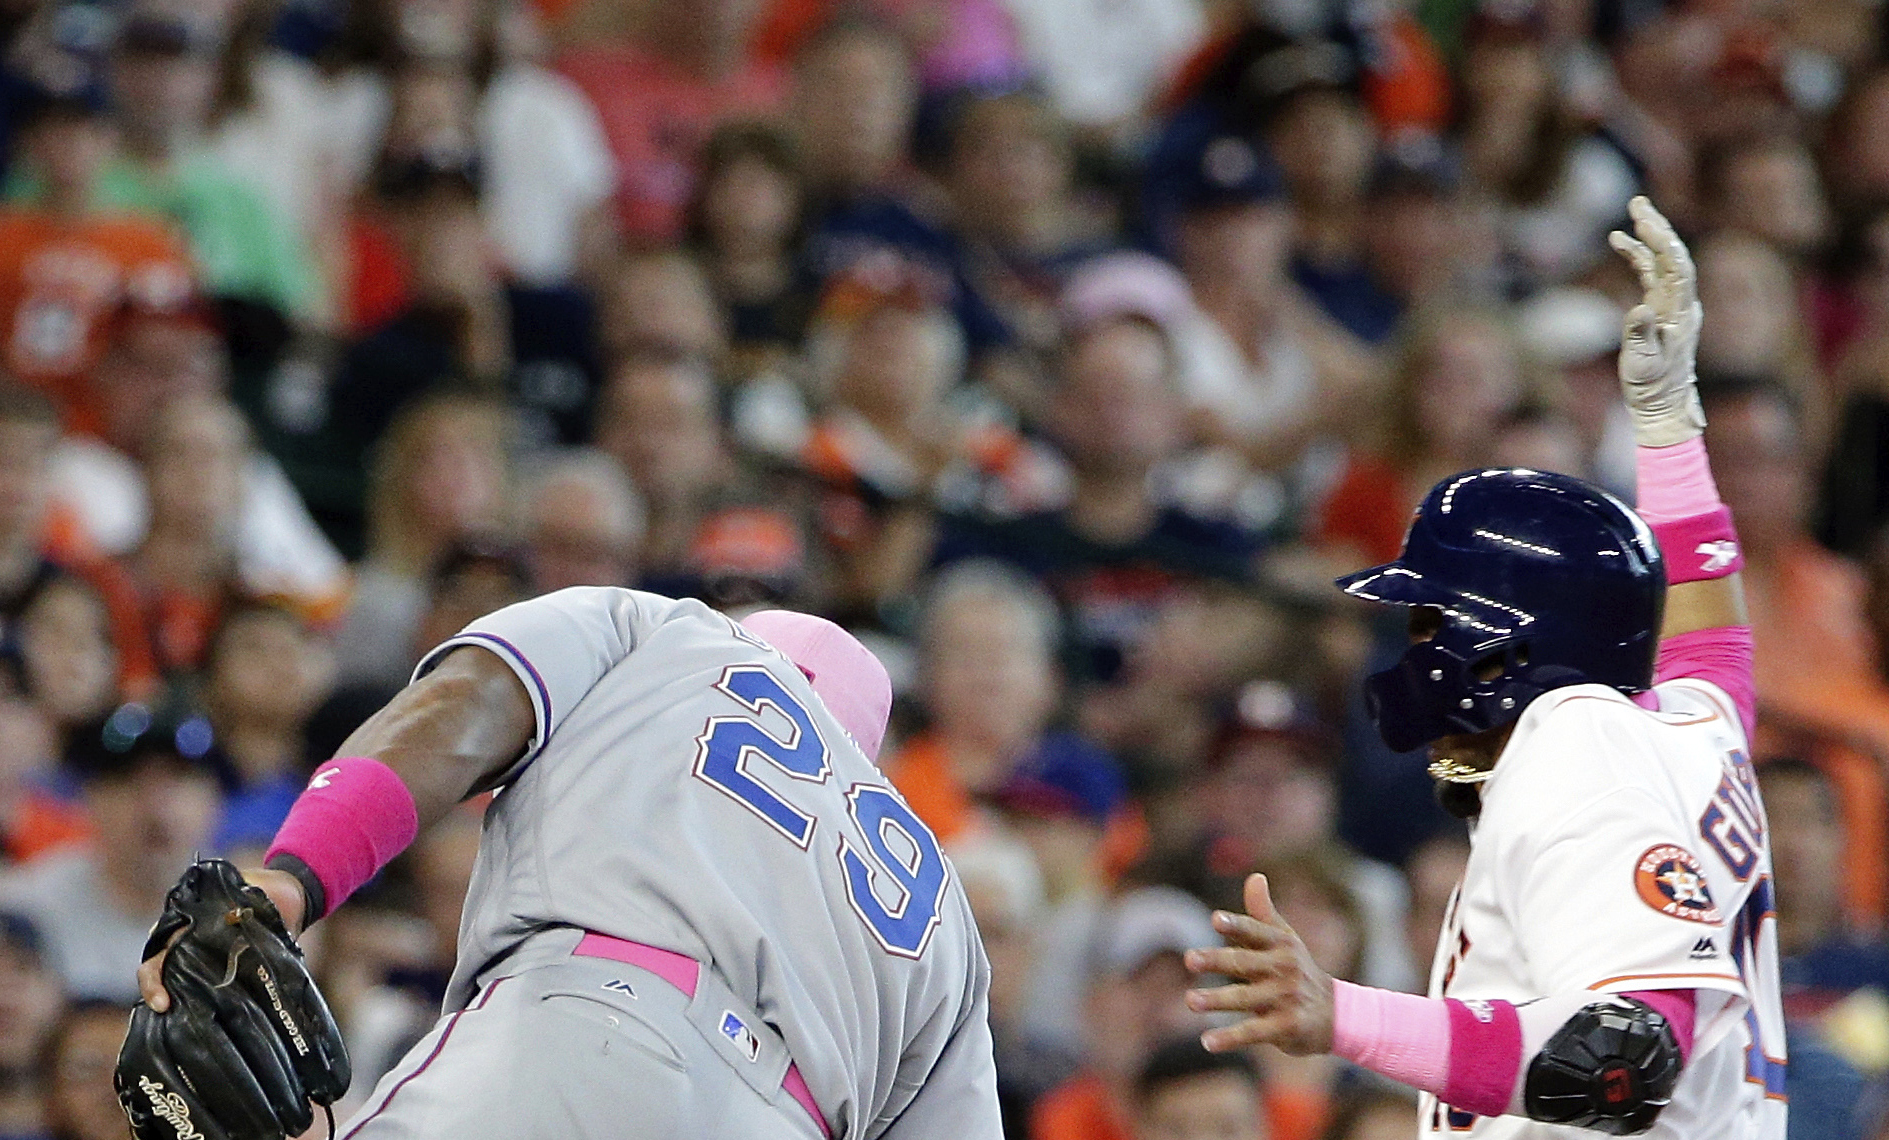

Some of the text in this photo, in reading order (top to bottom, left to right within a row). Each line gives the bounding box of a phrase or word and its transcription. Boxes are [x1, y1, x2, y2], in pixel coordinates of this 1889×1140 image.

[691, 663, 951, 961] 29
[264, 980, 283, 1012] GLOVE
[279, 1009, 299, 1037] GOLD
[292, 1034, 310, 1057] THE
